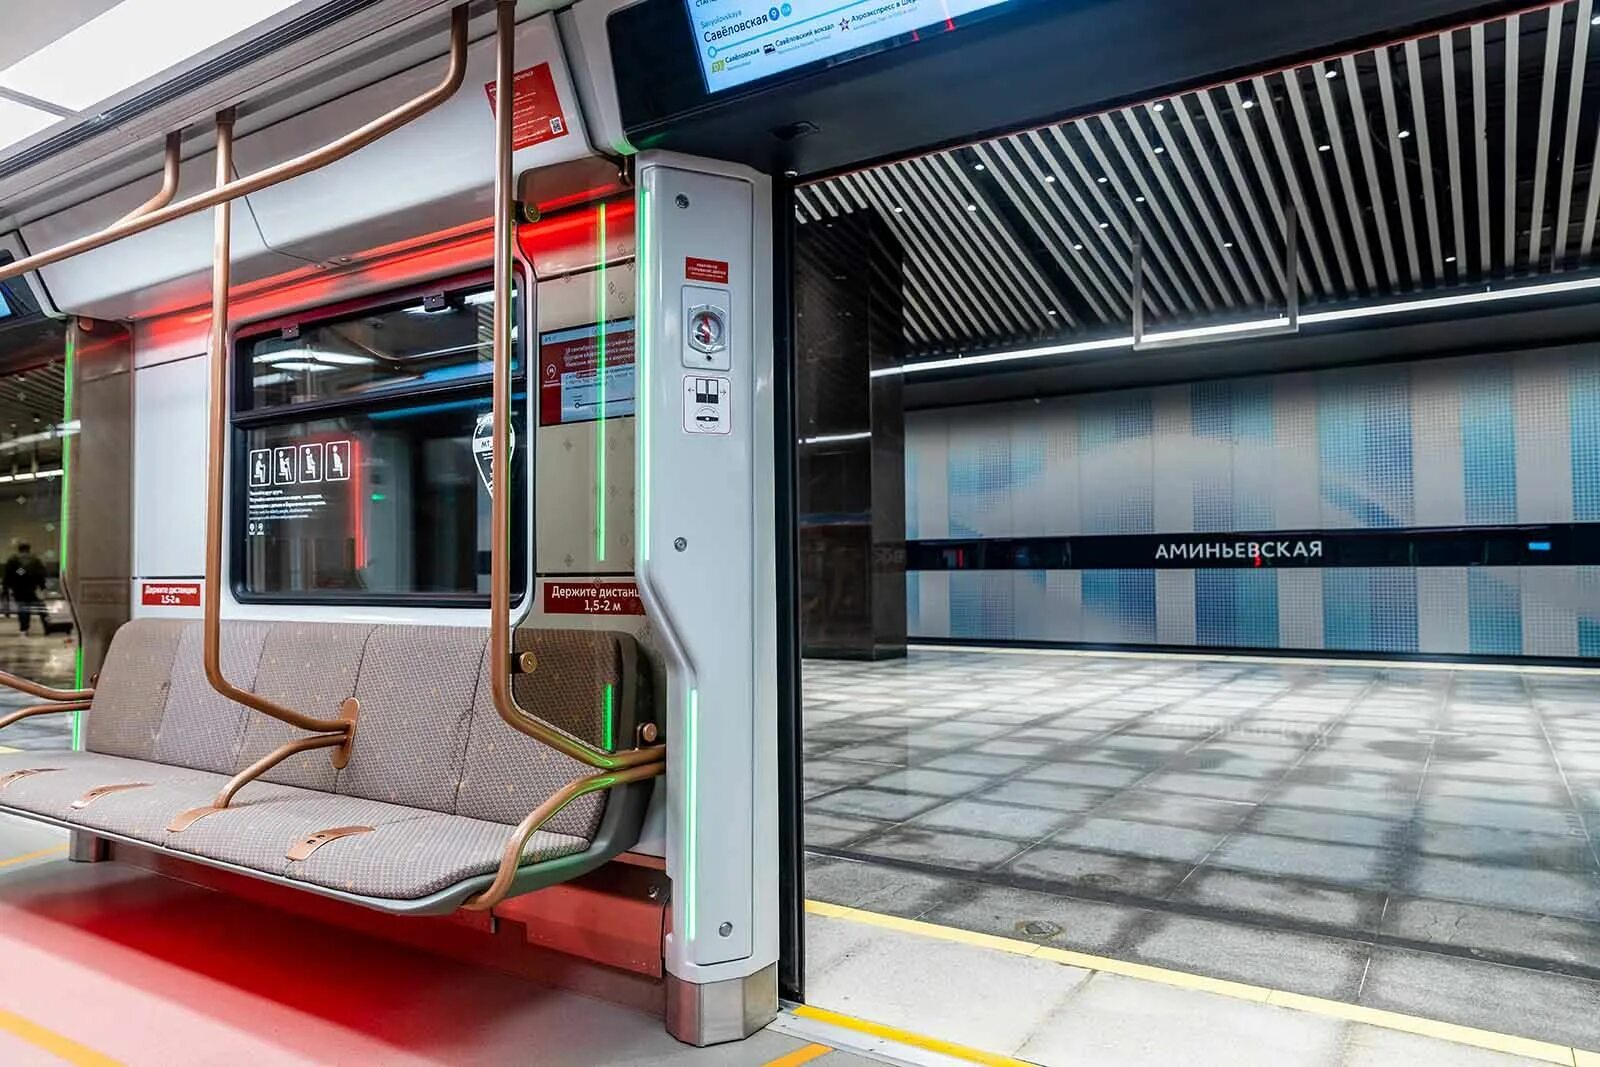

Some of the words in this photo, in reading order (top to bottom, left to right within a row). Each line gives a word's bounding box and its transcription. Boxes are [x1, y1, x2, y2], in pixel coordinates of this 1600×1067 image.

[704, 14, 768, 42] Савёловская
[775, 29, 813, 48] Савёловский
[814, 24, 835, 35] вокзал
[1155, 540, 1323, 560] АМИНЬЕВСКАЯ
[551, 585, 597, 599] Держите
[584, 599, 611, 612] 1,5-2
[612, 603, 622, 611] м
